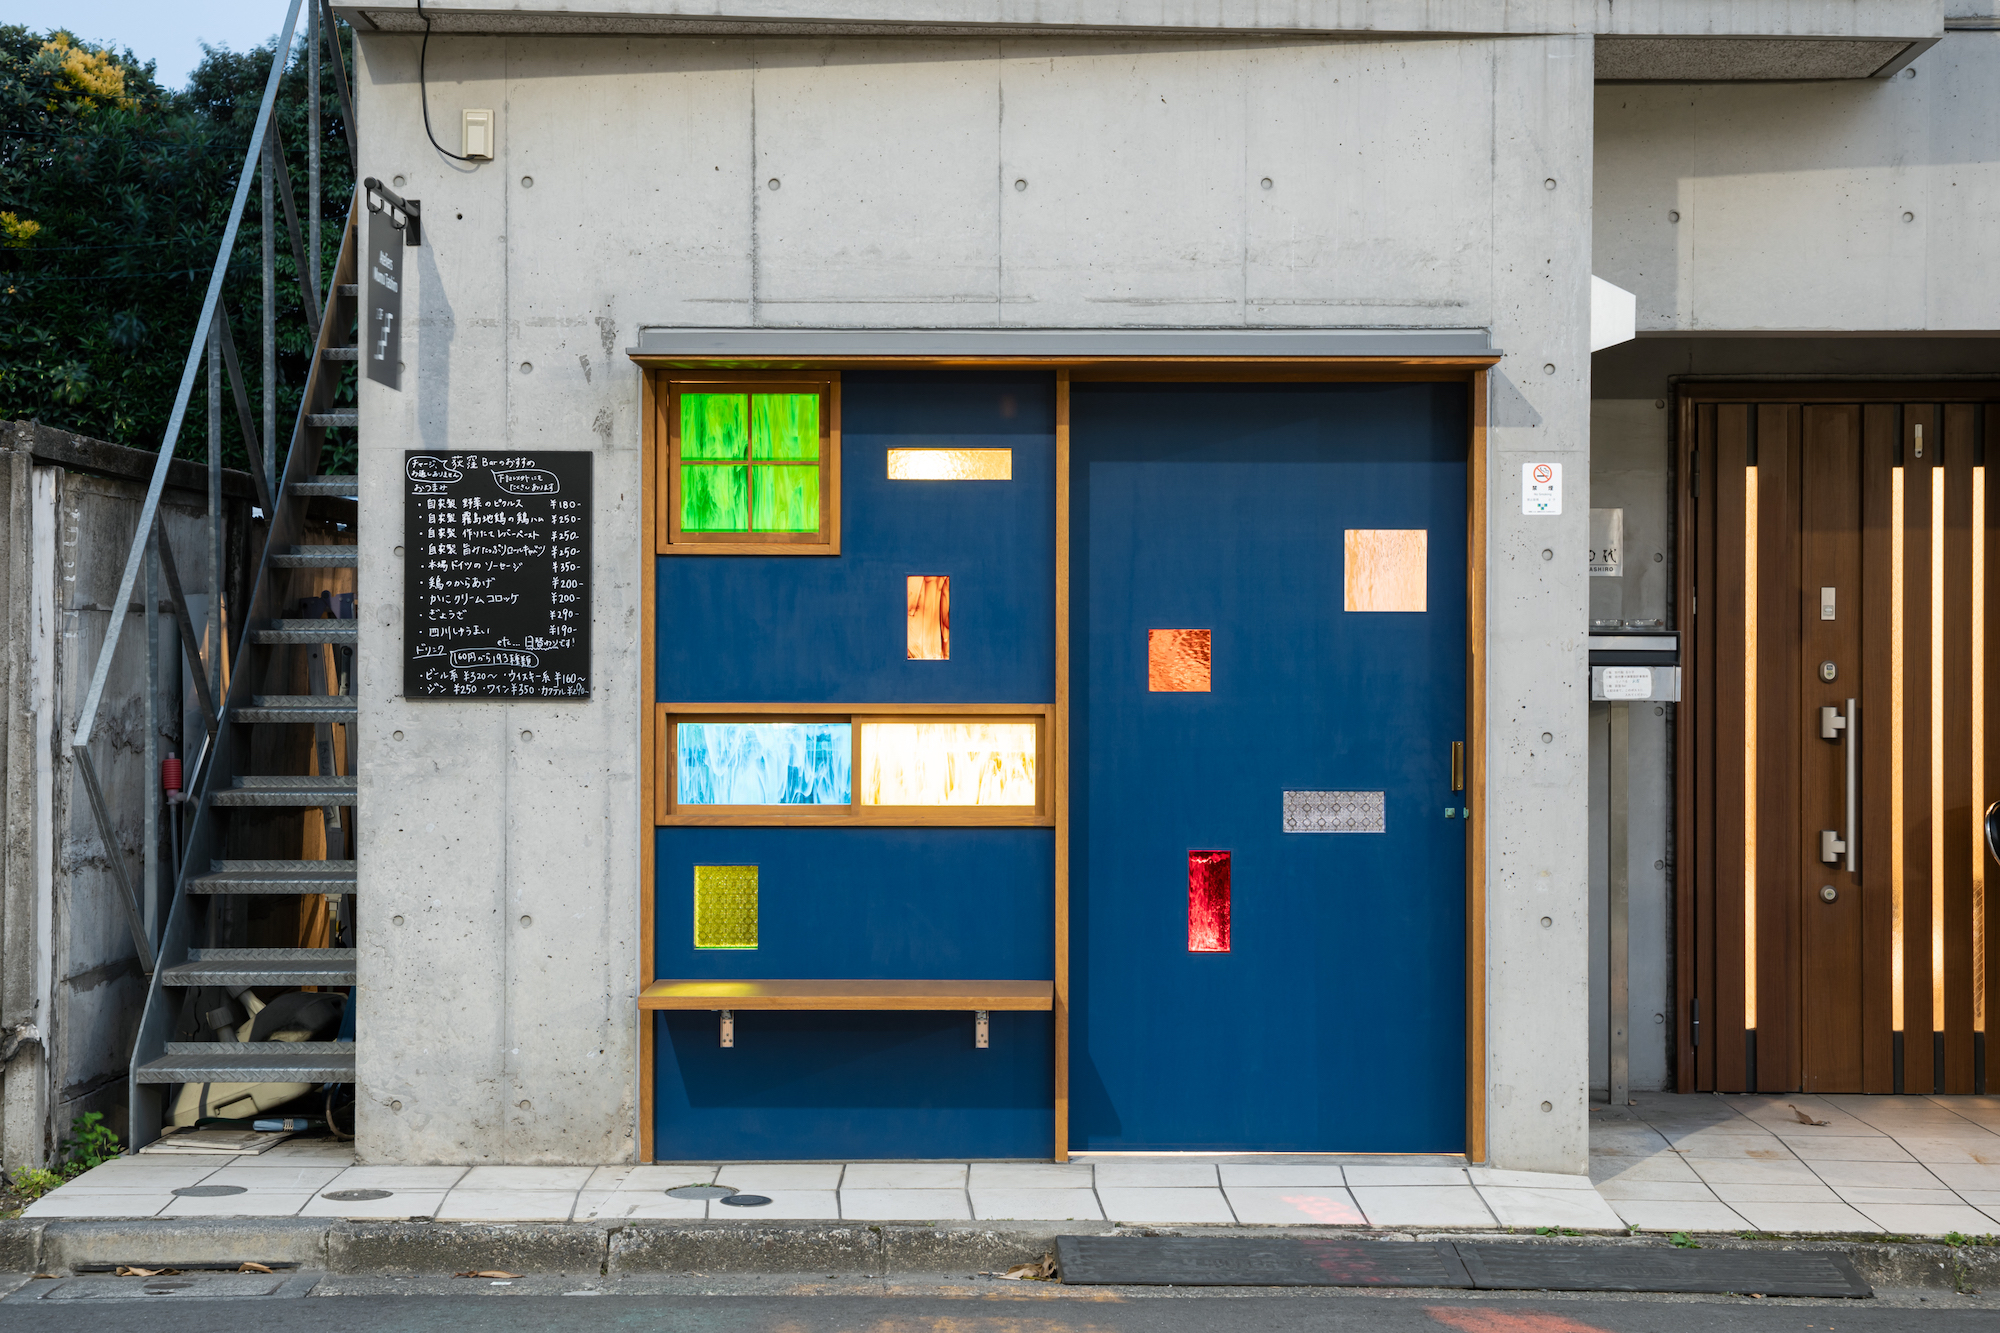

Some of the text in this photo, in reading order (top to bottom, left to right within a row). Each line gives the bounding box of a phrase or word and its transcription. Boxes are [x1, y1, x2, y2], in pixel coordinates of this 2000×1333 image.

[414, 483, 448, 493] おつまみ
[427, 498, 457, 510] 自家製
[429, 513, 456, 524] 自家製
[428, 527, 457, 539] 自家製
[429, 543, 457, 555] 自家製
[429, 576, 495, 590] 鶏のからあげ
[429, 609, 467, 620] ぎょうざ
[427, 684, 446, 694] ジン
[487, 685, 509, 694] ワイン
